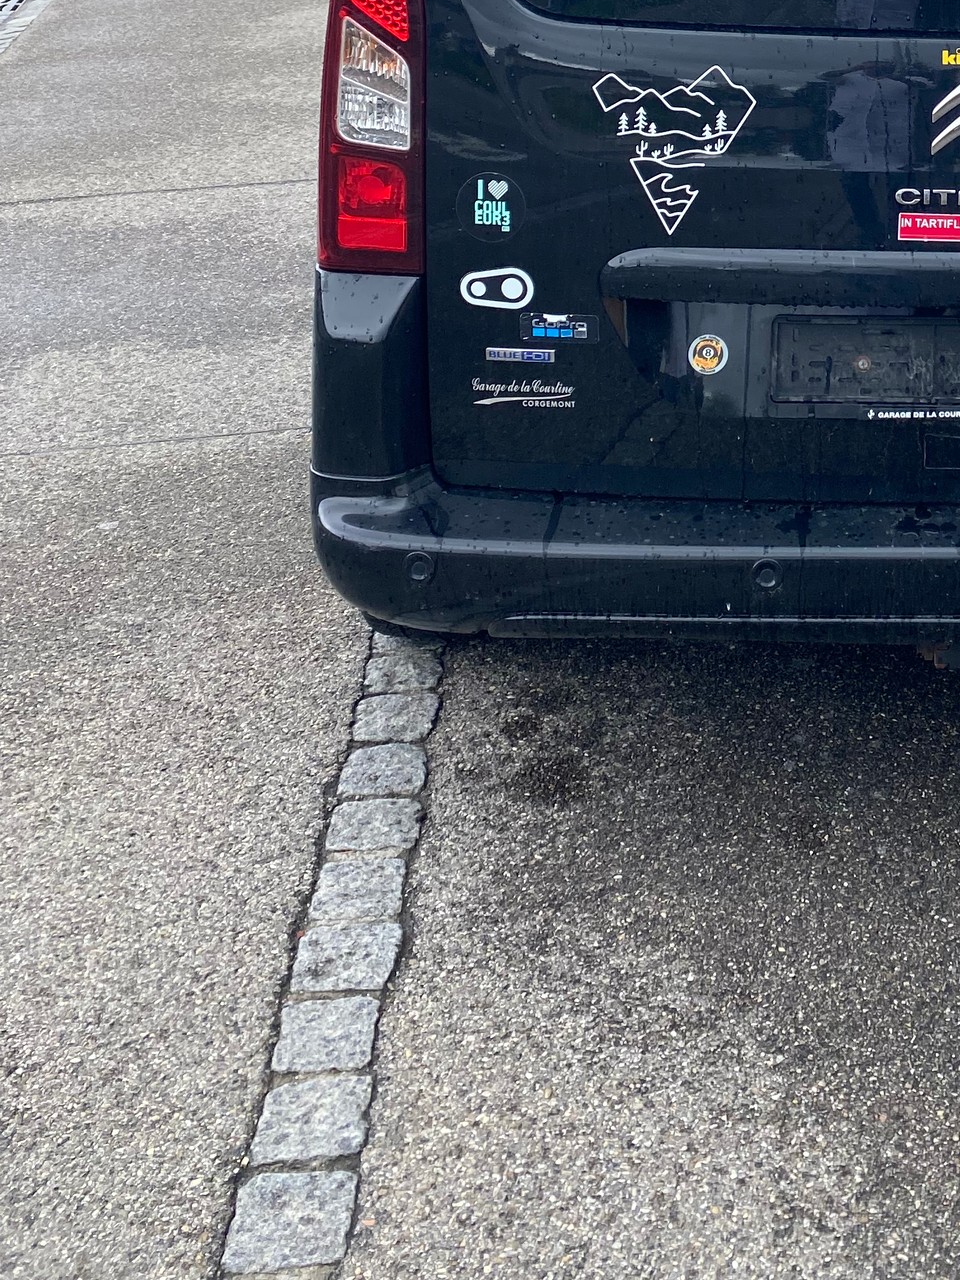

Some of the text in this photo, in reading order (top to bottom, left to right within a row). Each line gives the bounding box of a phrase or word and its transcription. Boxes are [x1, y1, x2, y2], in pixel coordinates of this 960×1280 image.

[901, 217, 912, 228] IN
[471, 377, 506, 397] Garage
[507, 380, 519, 393] de
[520, 380, 530, 393] la
[522, 400, 575, 408] CORGEMONT
[877, 411, 912, 419] GARAGE
